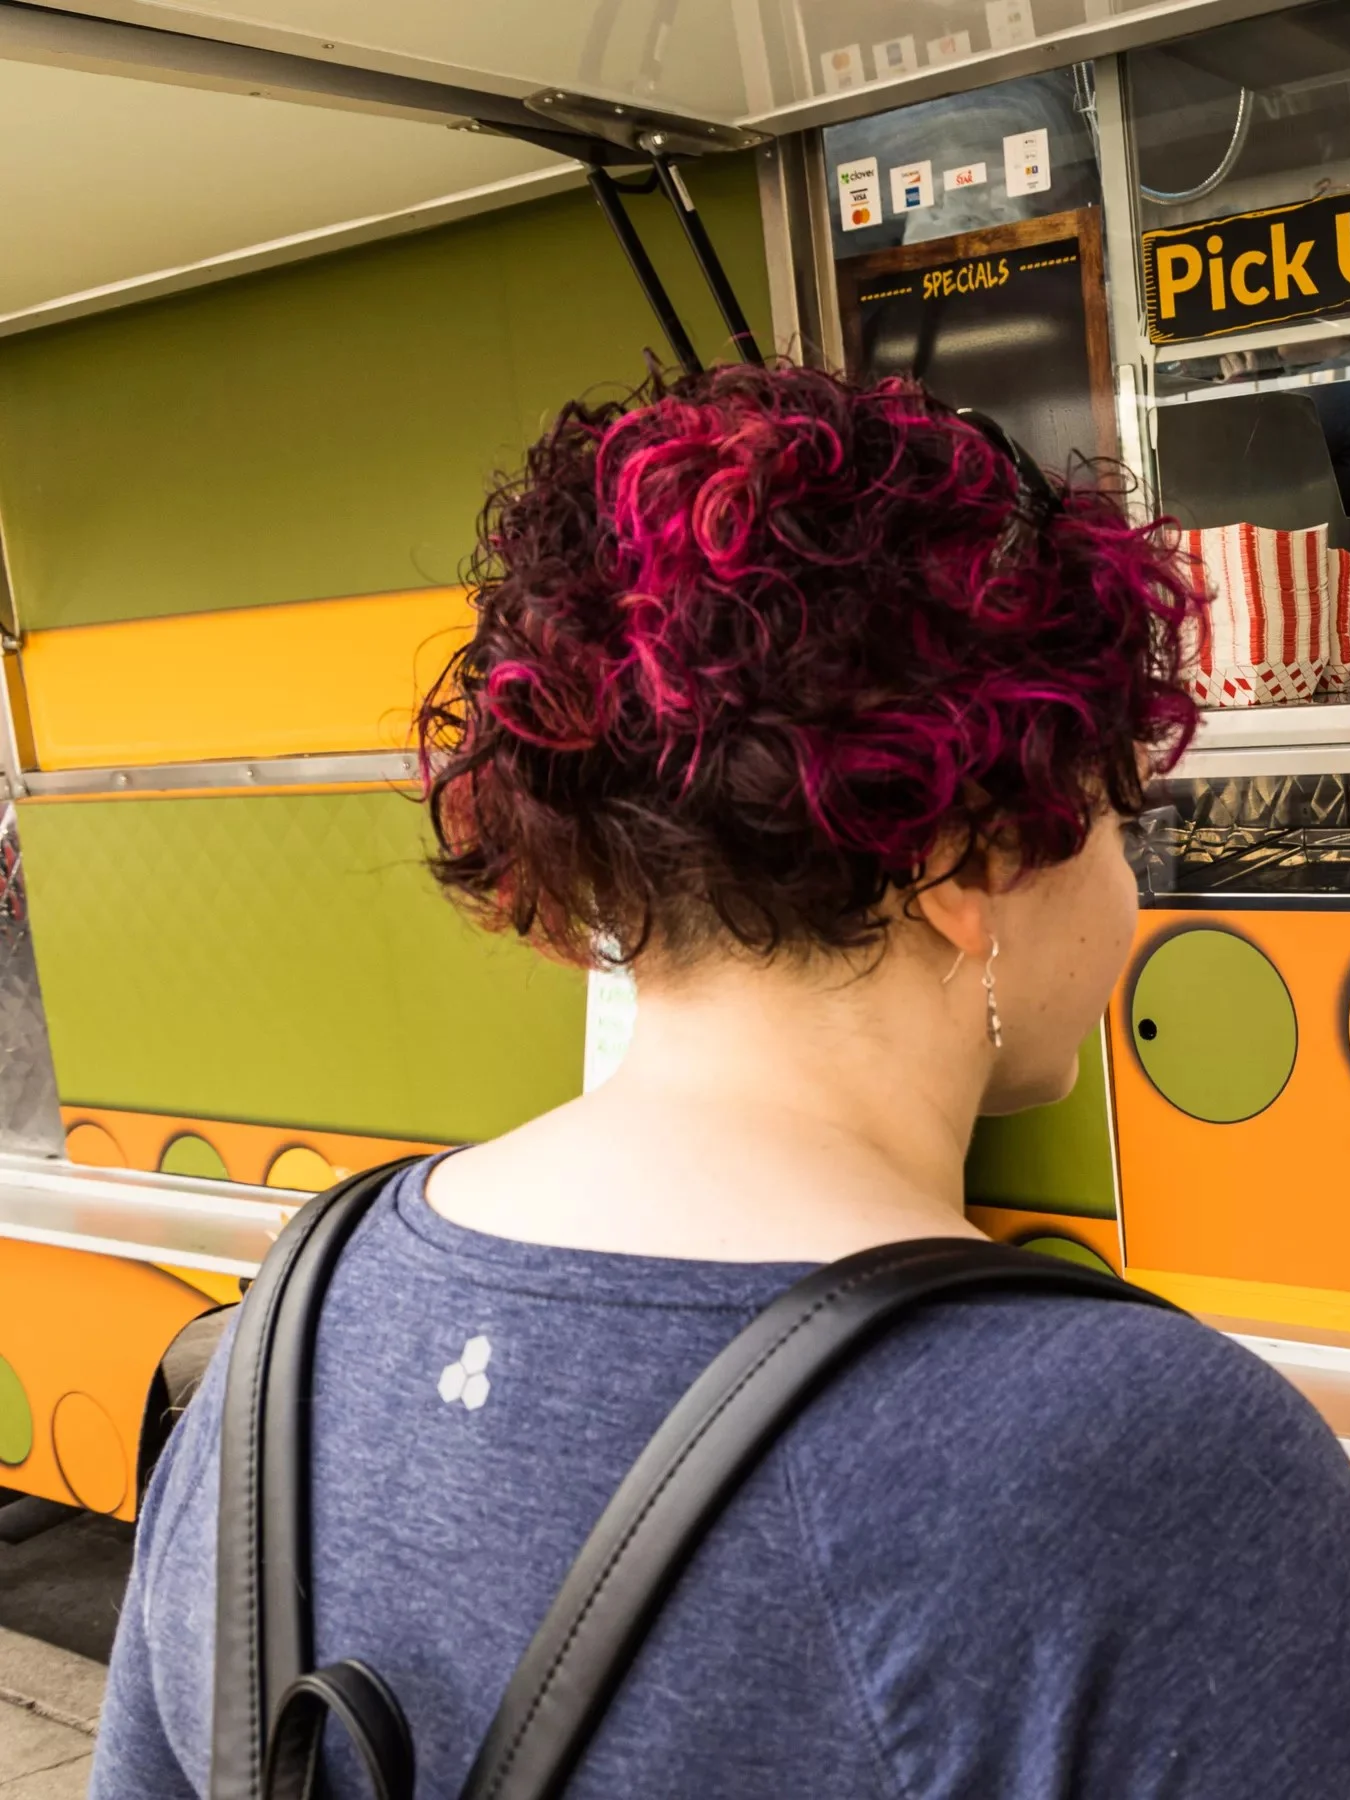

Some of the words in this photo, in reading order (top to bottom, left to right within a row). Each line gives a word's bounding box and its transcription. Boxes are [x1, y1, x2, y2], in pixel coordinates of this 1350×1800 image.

[850, 168, 875, 181] clover
[852, 193, 867, 201] VISA
[1156, 222, 1319, 319] Pick
